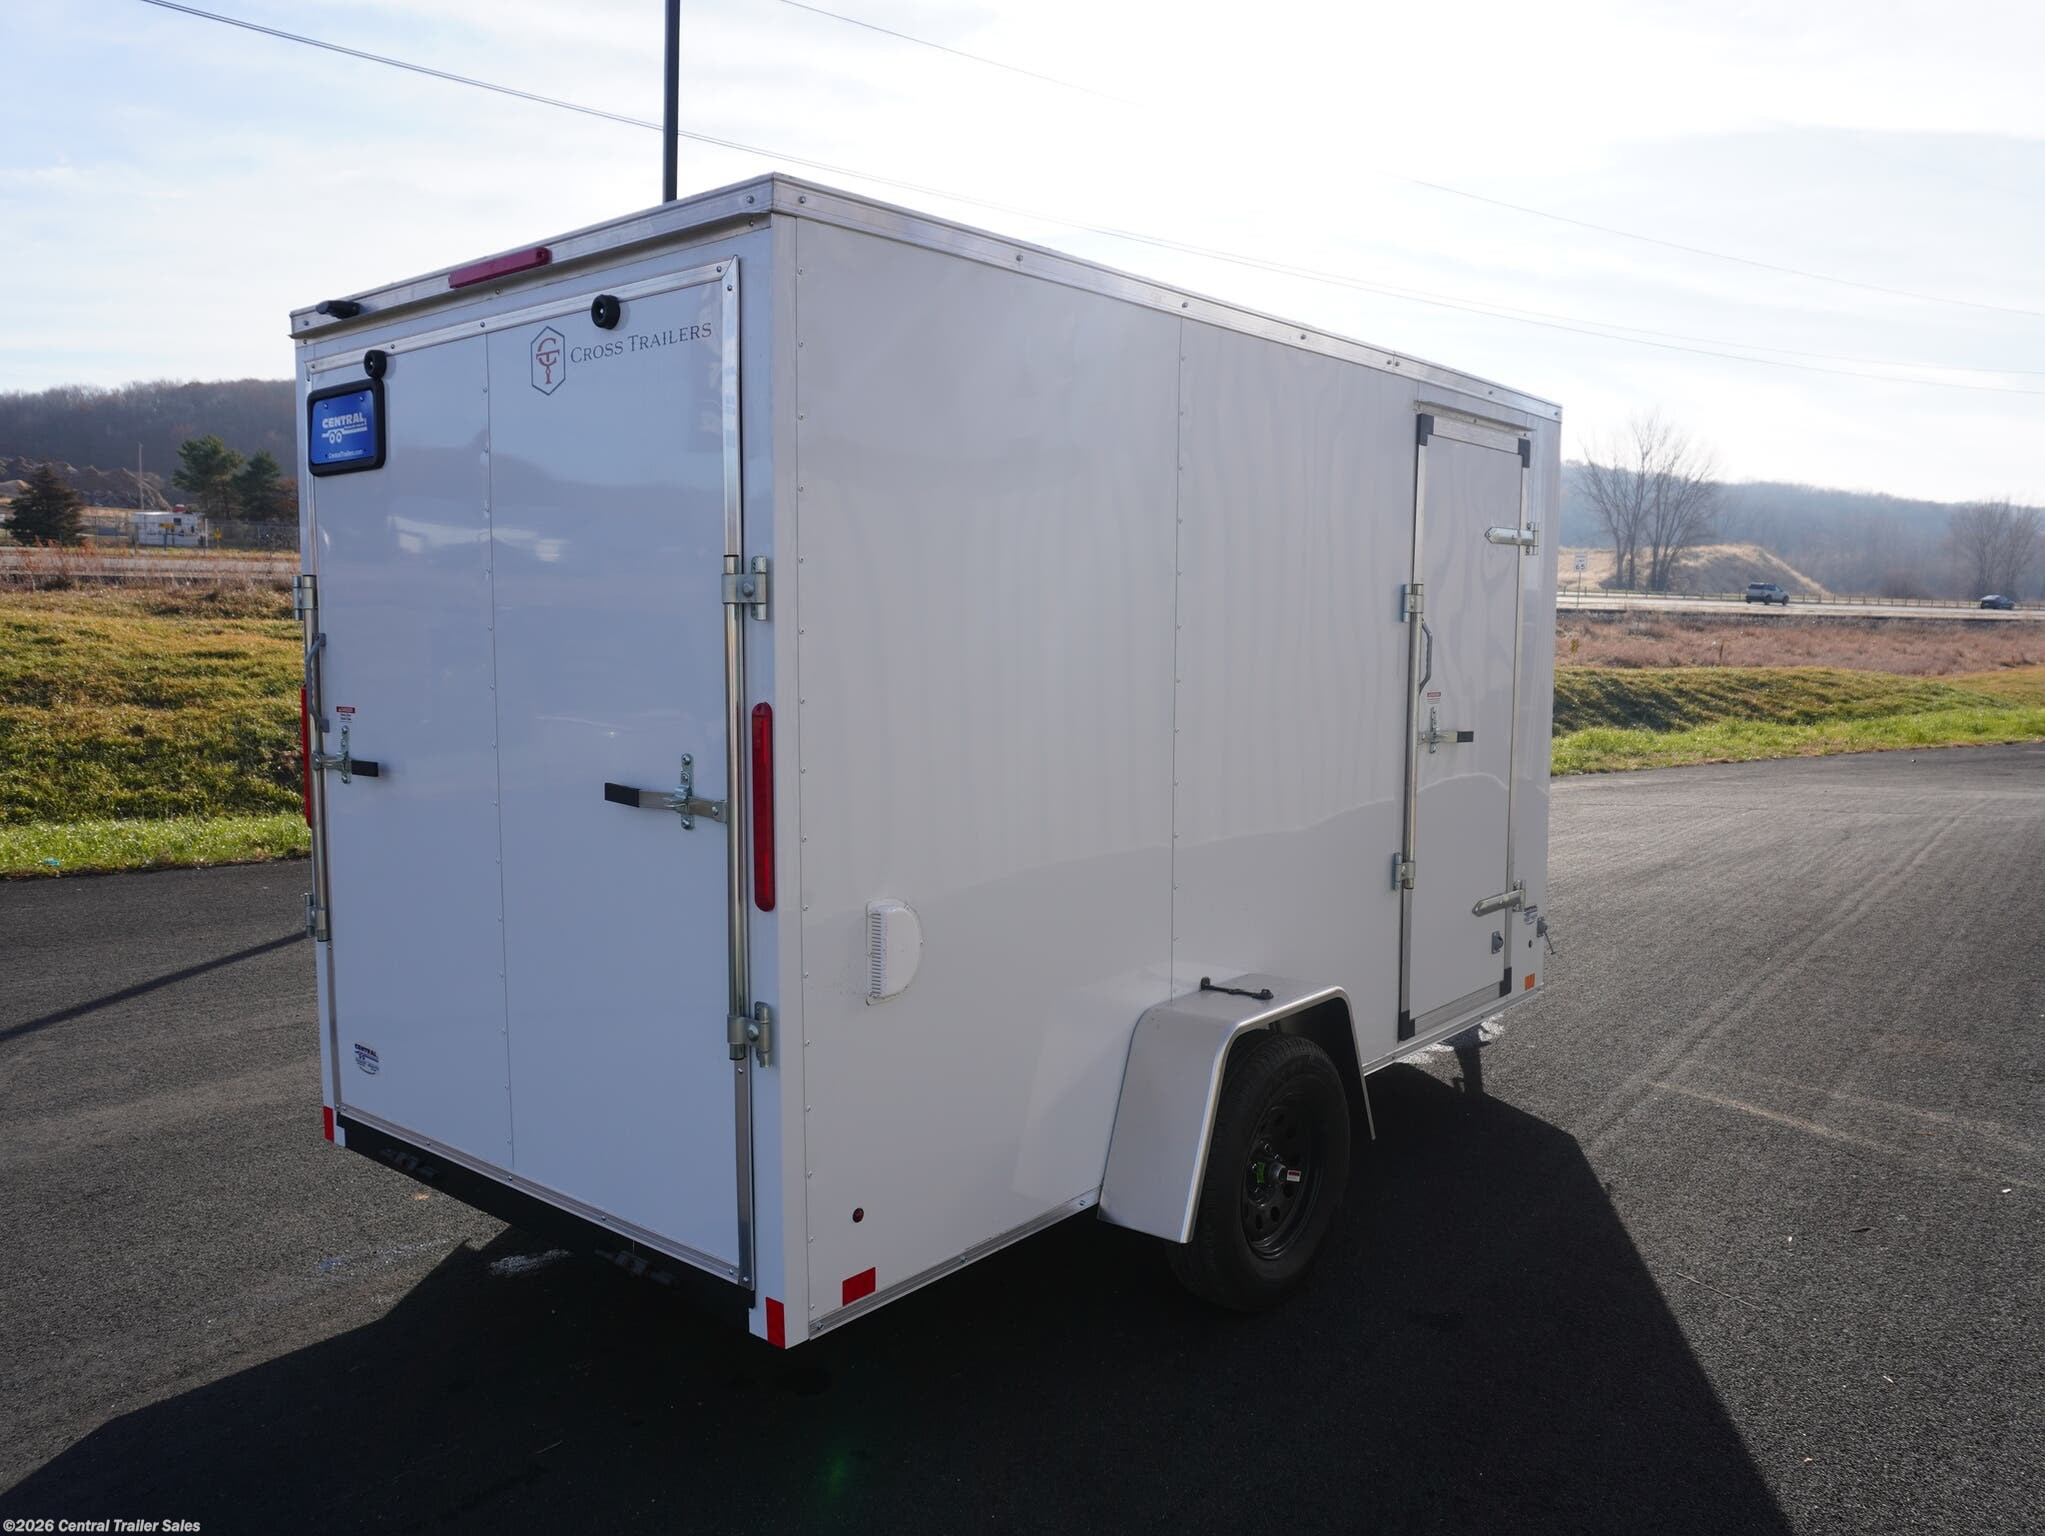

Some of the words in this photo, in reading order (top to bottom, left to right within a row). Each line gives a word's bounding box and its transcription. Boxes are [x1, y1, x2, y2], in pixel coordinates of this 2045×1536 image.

[570, 341, 624, 364] CROSS
[627, 322, 712, 353] TRAILERS
[322, 412, 364, 429] CENTRAL
